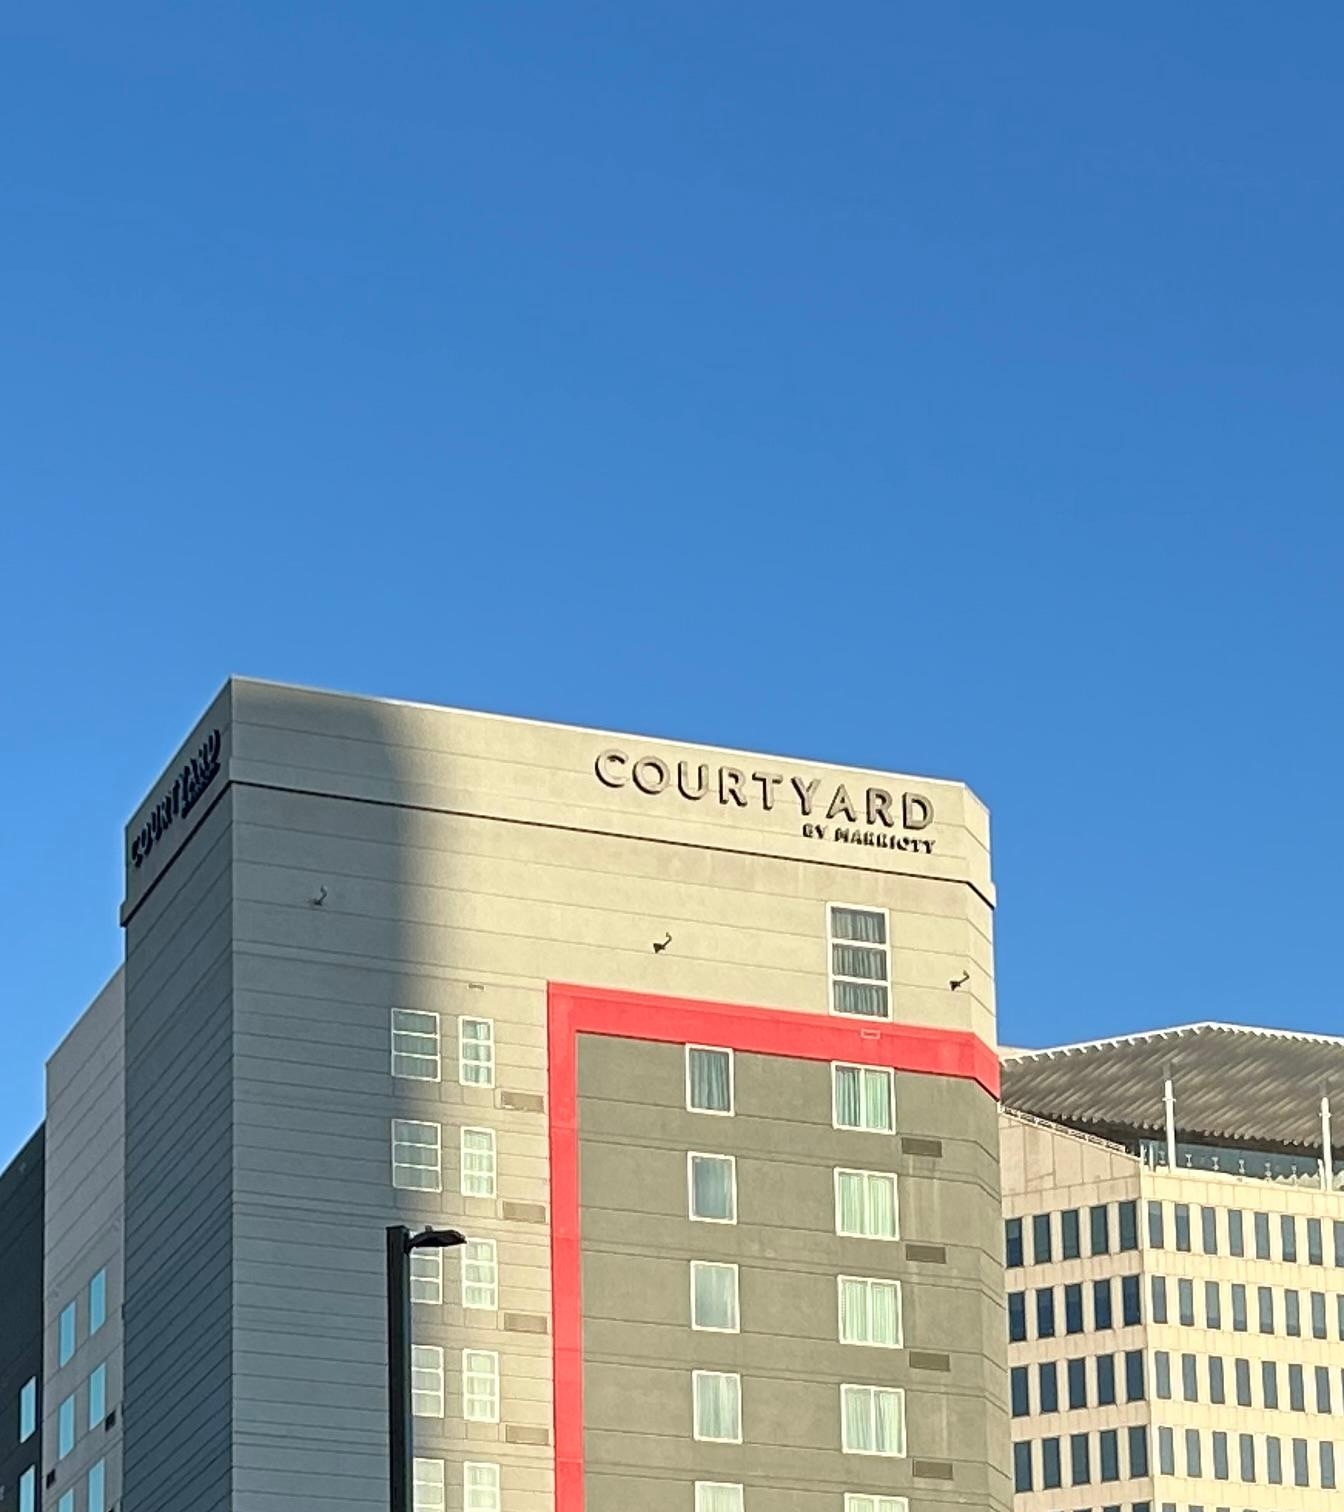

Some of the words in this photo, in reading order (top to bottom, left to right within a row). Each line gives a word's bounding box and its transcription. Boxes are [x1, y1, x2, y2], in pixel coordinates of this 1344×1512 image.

[594, 749, 935, 831] COURTYARD
[802, 823, 828, 839] BY
[834, 827, 936, 854] MARRIOTT
